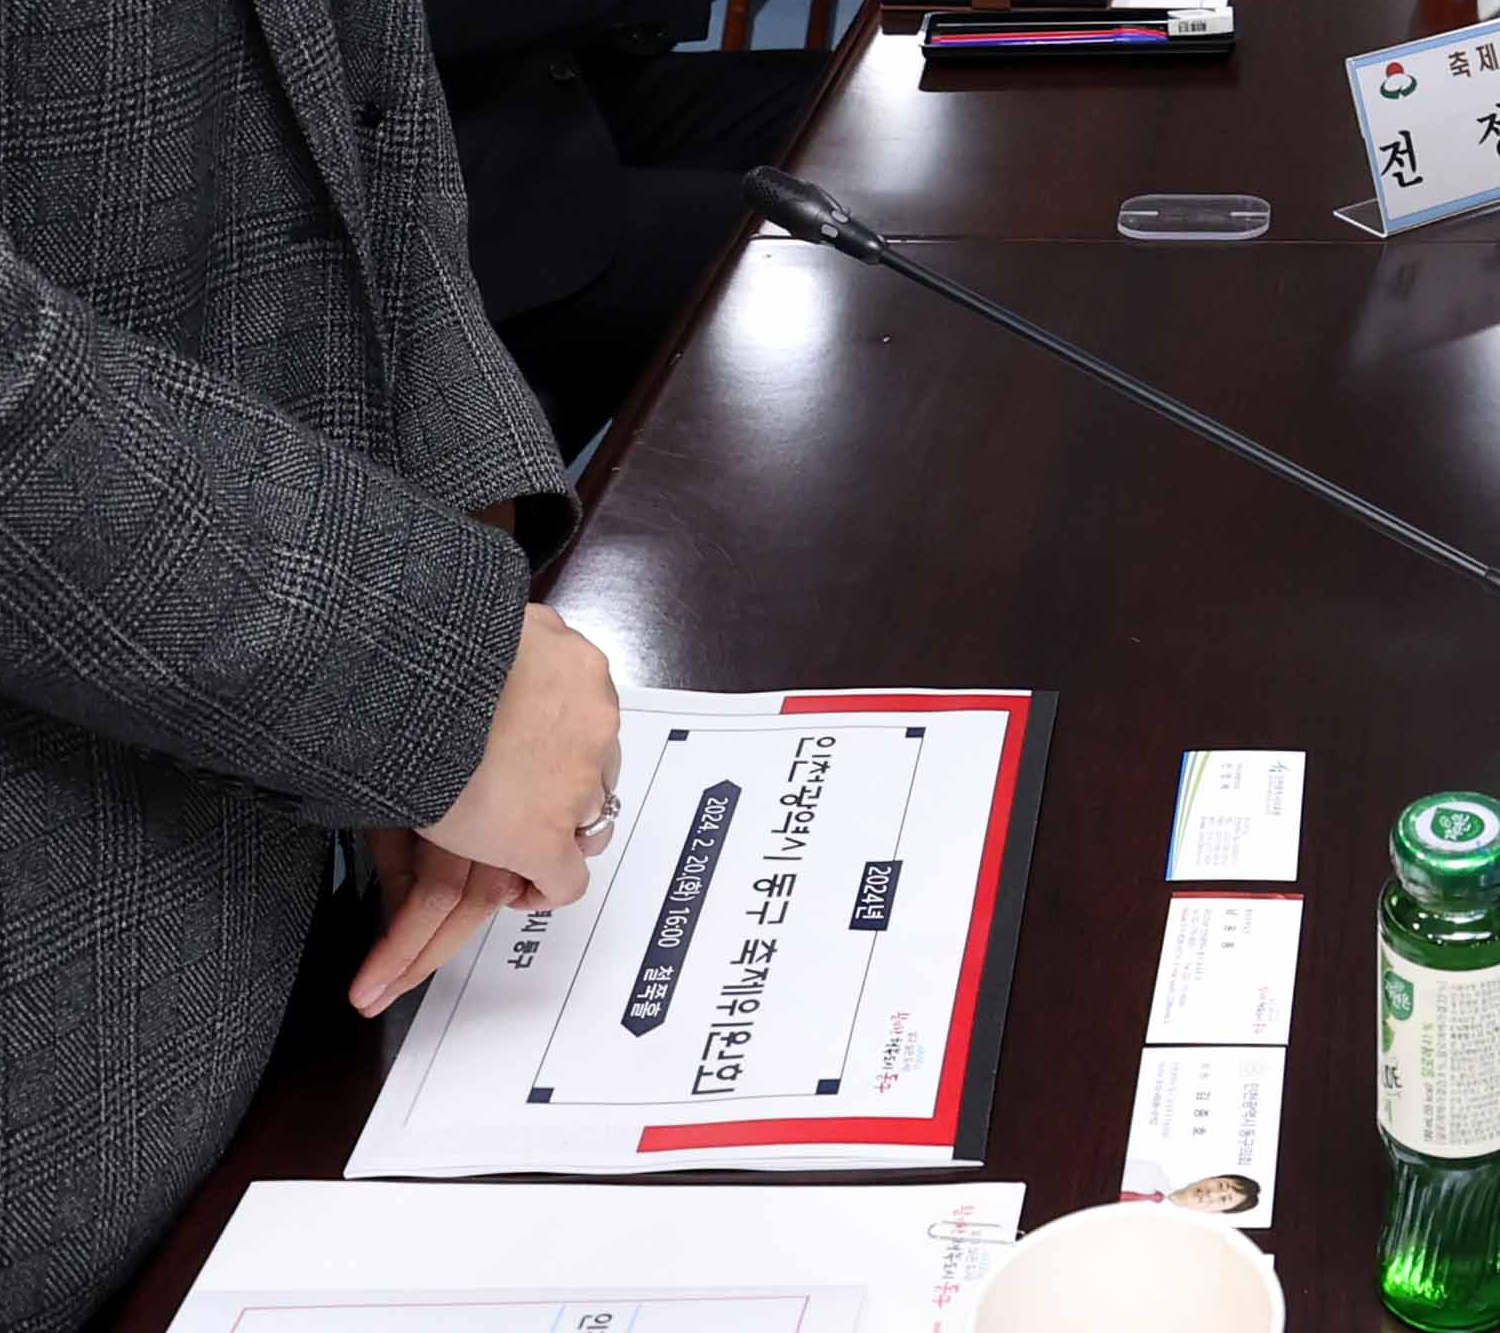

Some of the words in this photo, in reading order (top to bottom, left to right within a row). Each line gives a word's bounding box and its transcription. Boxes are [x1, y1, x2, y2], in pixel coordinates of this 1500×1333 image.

[696, 796, 729, 834] 2024.
[762, 735, 837, 861] 인천광역시
[691, 837, 715, 851] 2.
[669, 855, 709, 902] 20.(화)
[745, 872, 798, 926] 동구
[855, 864, 893, 921] 2024년
[657, 906, 691, 949] 16:00
[506, 939, 542, 970] 동구
[630, 965, 674, 1019] 철쭉홀
[691, 937, 778, 1096] 축제위원회
